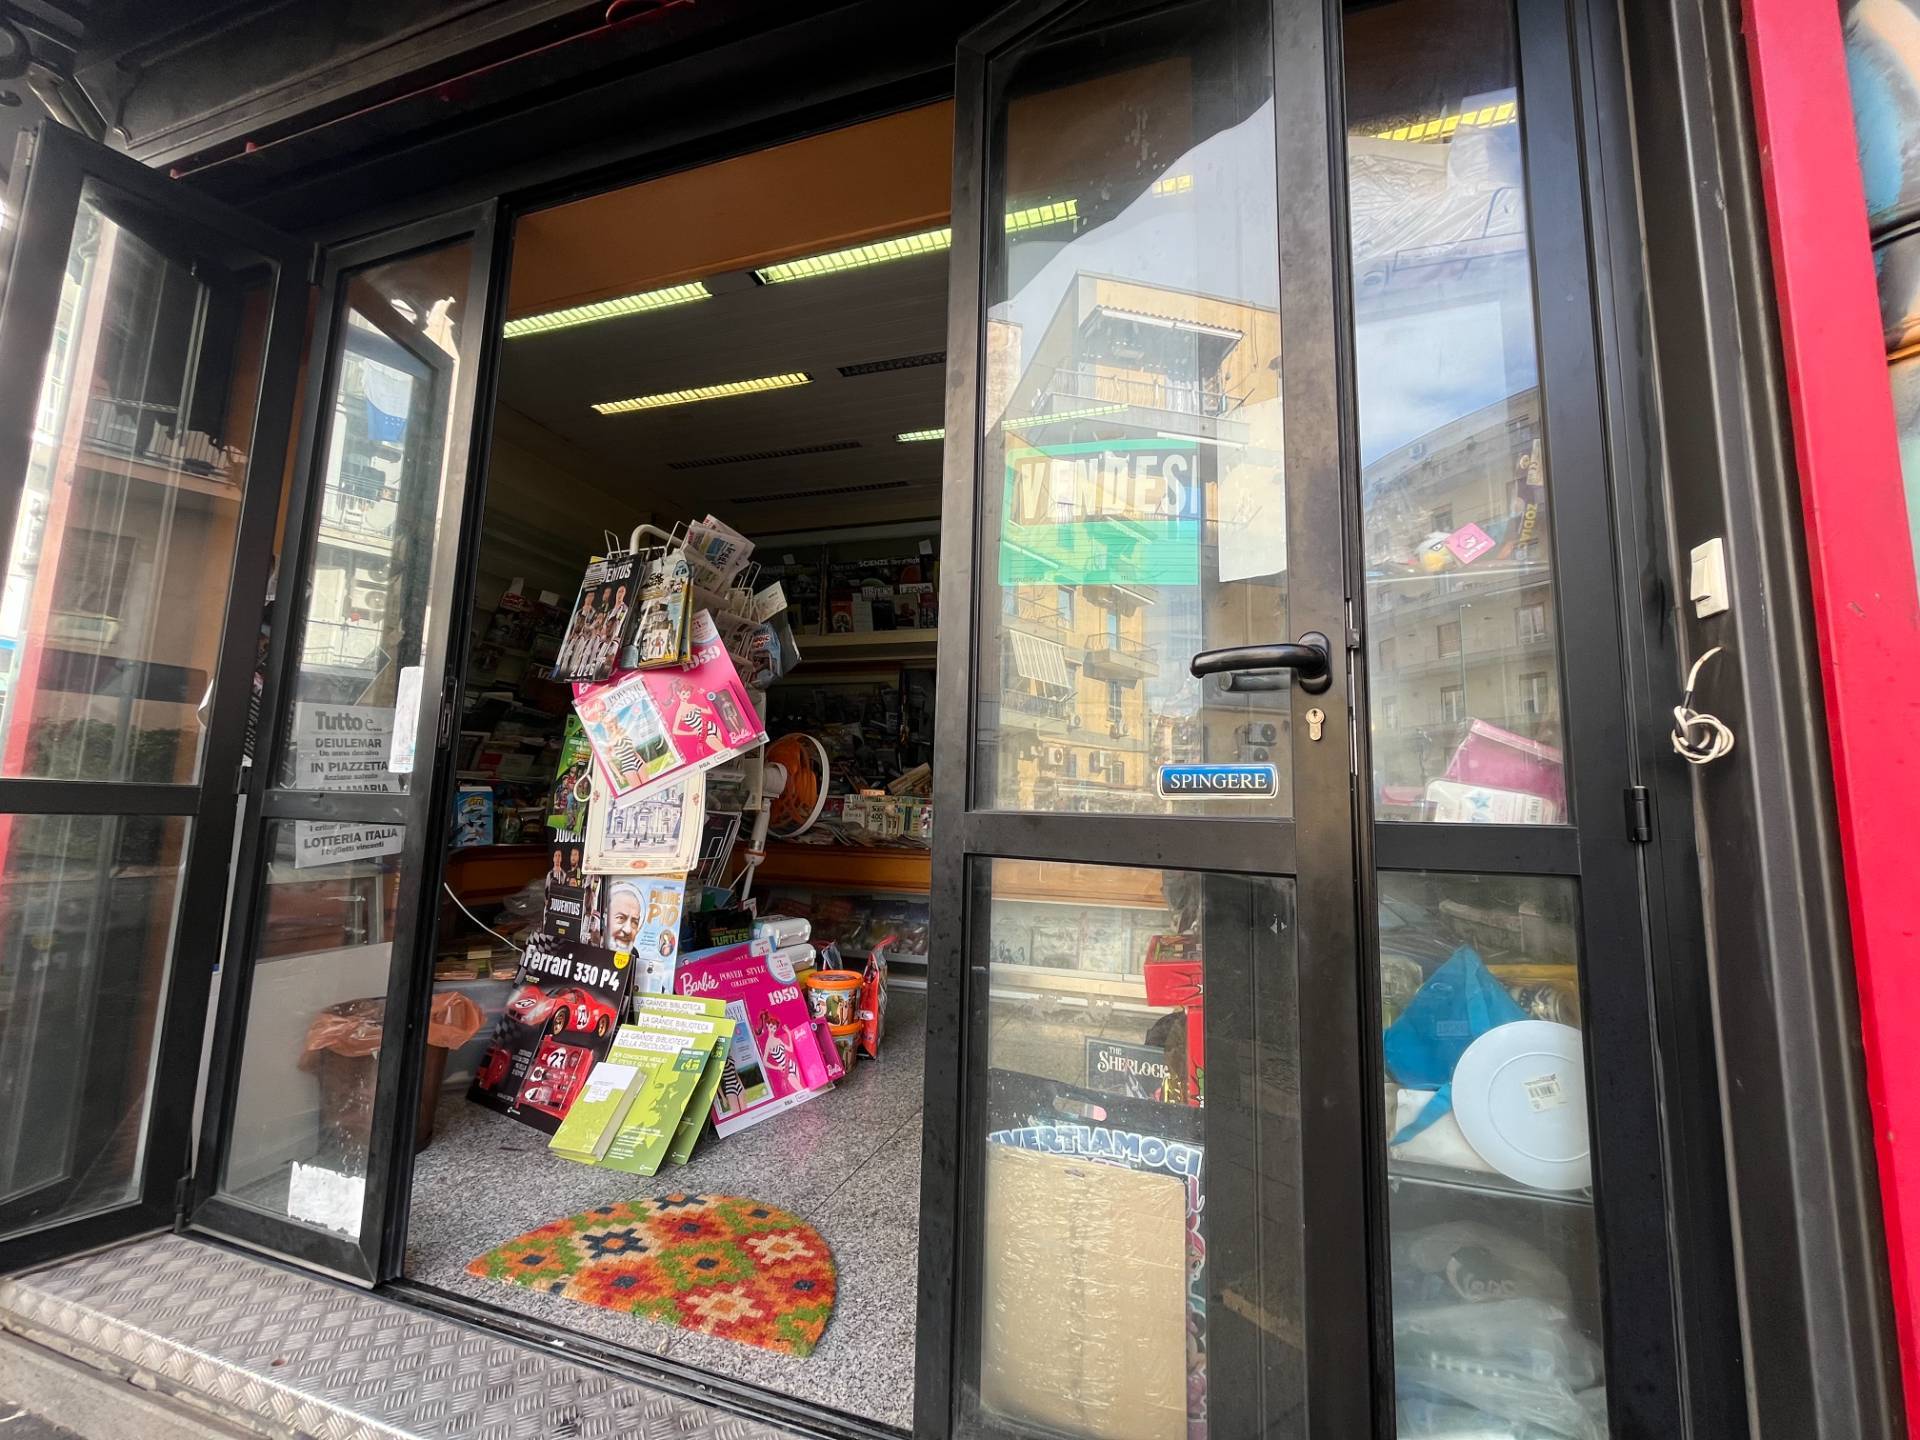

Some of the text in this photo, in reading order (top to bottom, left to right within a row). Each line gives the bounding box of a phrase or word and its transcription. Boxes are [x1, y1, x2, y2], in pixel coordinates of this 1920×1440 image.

[1020, 453, 1198, 519] VENDESI
[602, 563, 633, 583] ENTUS
[315, 711, 363, 731] Tutto
[315, 738, 382, 748] DEIULEMAR
[311, 761, 388, 773] IN PIAZZETTA
[1170, 773, 1268, 789] SPINGERE
[304, 828, 398, 849] LOTTERIA ITALIA
[356, 841, 384, 850] vincenti
[550, 898, 580, 916] JUVENTUS
[711, 933, 749, 946] TURTLES
[523, 944, 620, 992] Ferrari 330 P4
[680, 966, 767, 997] Barbie POWER STYLE
[730, 977, 760, 988] COLLECTION
[768, 986, 799, 1006] 1959
[1108, 1046, 1122, 1056] THE
[1097, 1050, 1169, 1079] SHERLOCK
[986, 1125, 1203, 1177] VERTIAMOCI
